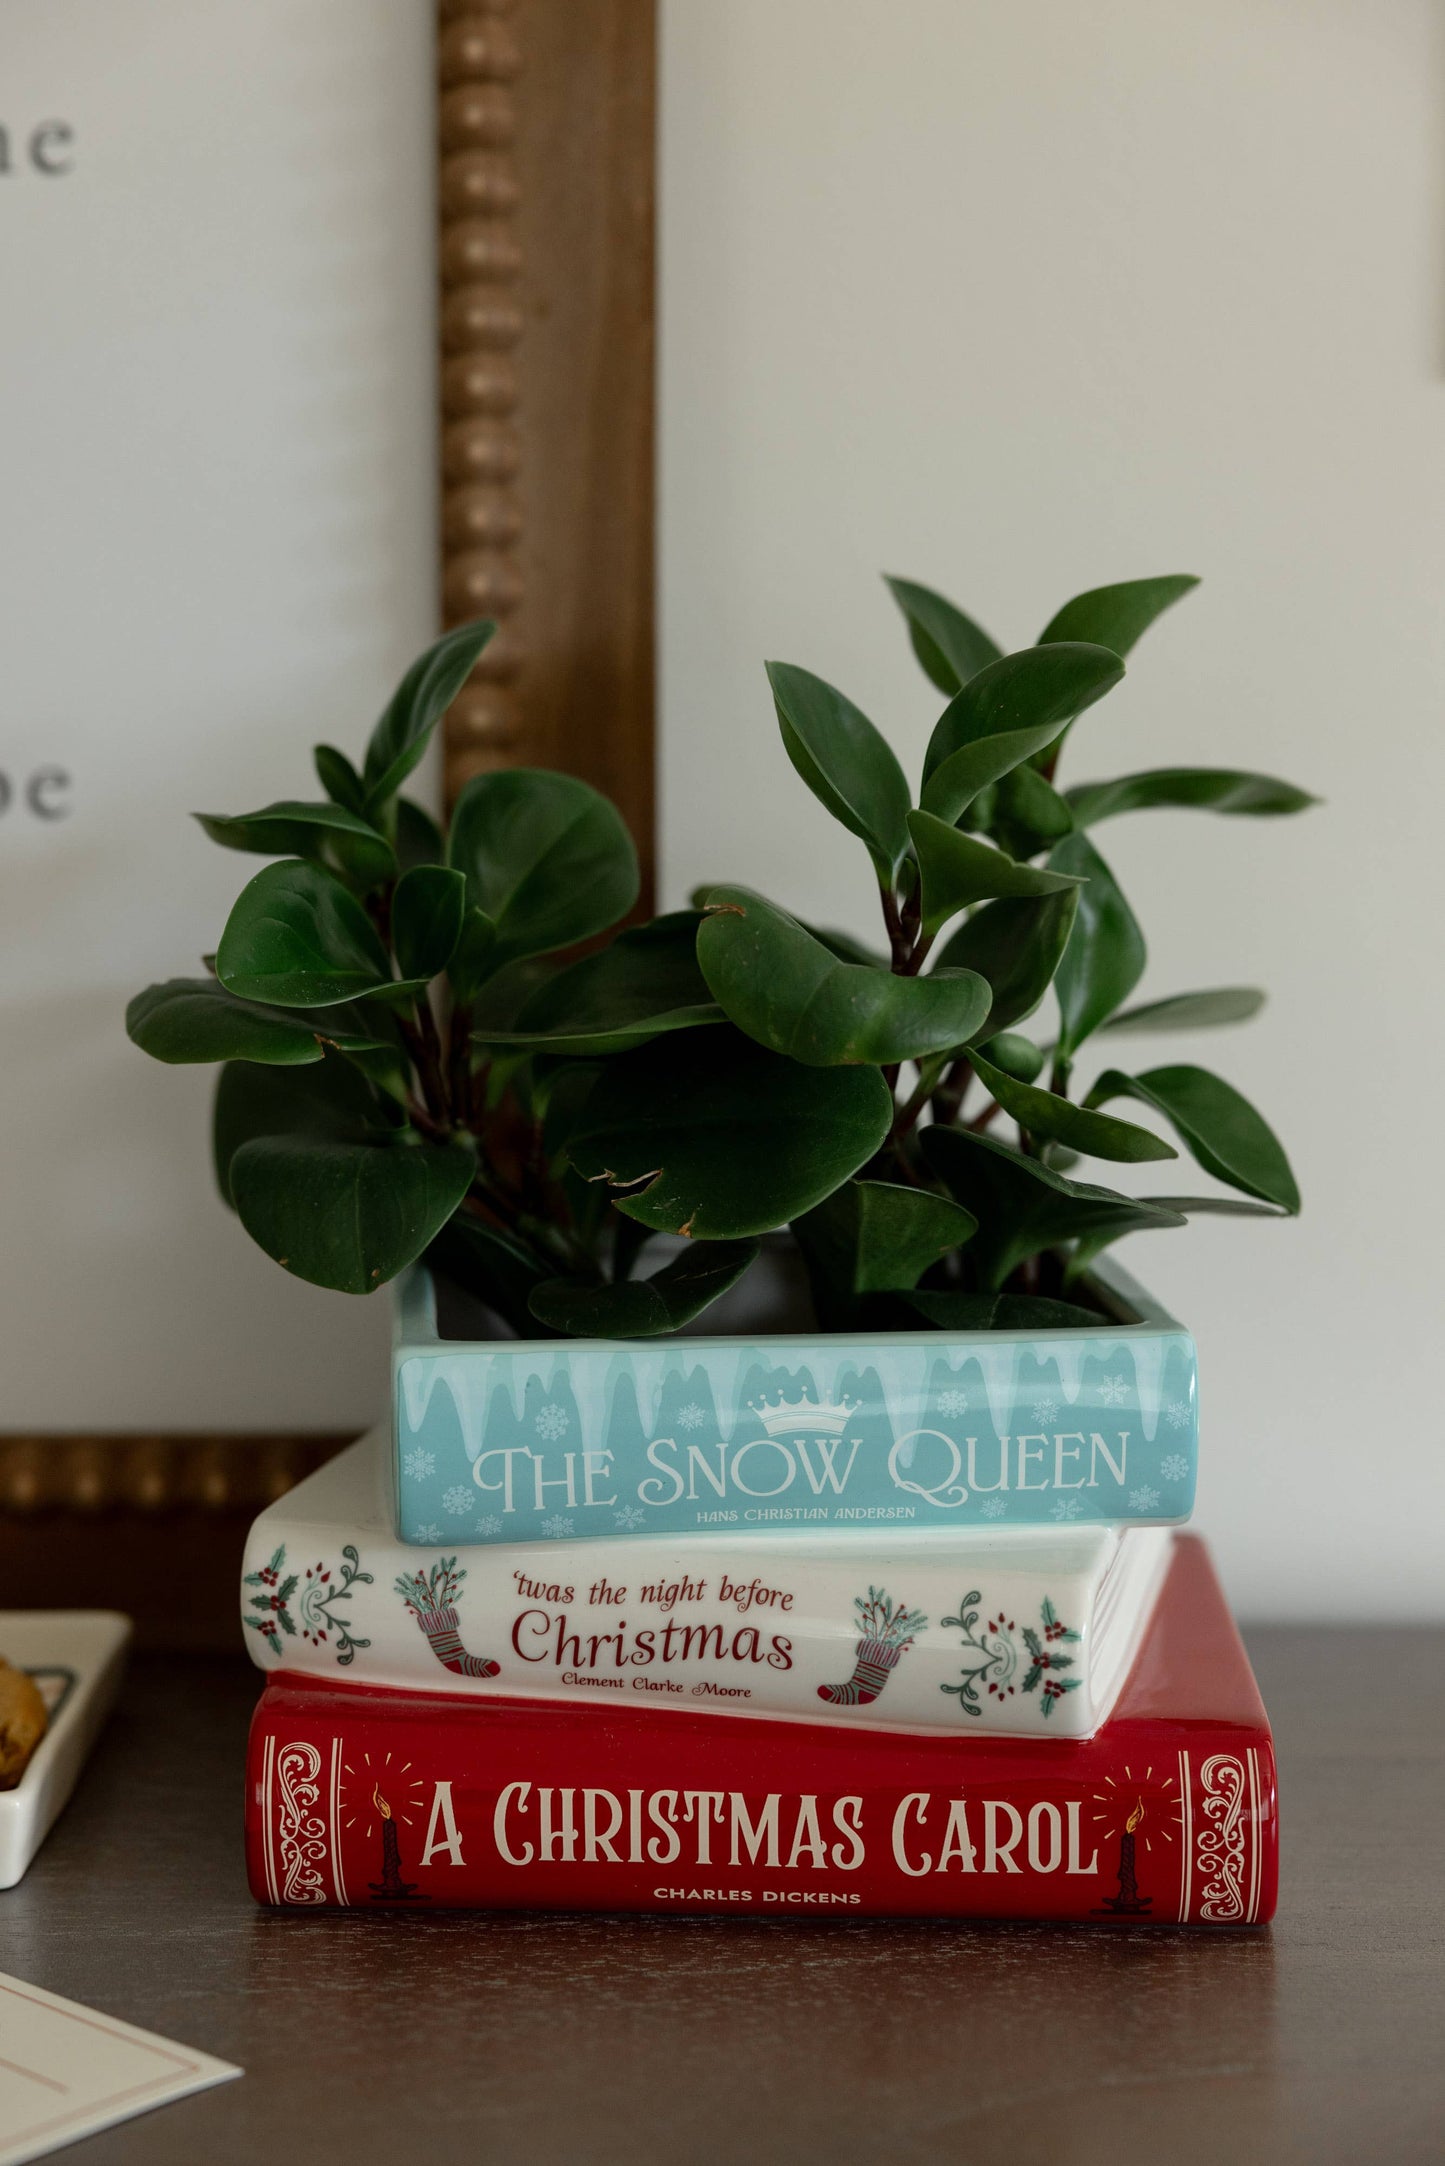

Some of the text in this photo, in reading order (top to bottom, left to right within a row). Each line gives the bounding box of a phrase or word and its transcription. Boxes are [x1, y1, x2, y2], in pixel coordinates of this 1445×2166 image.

[473, 1430, 1131, 1513] THE SNOW QUEEN
[697, 1507, 916, 1523] HANS CHRISTIAN ANDERSEN
[589, 1578, 627, 1605] the
[640, 1575, 707, 1612] night
[719, 1575, 794, 1613] before
[511, 1609, 793, 1671] Christmas
[561, 1672, 752, 1698] Clement Clarke Moore
[418, 1780, 1100, 1877] A CHRISTMAS CAROL
[653, 1886, 862, 1904] CHARLES DICKENS
